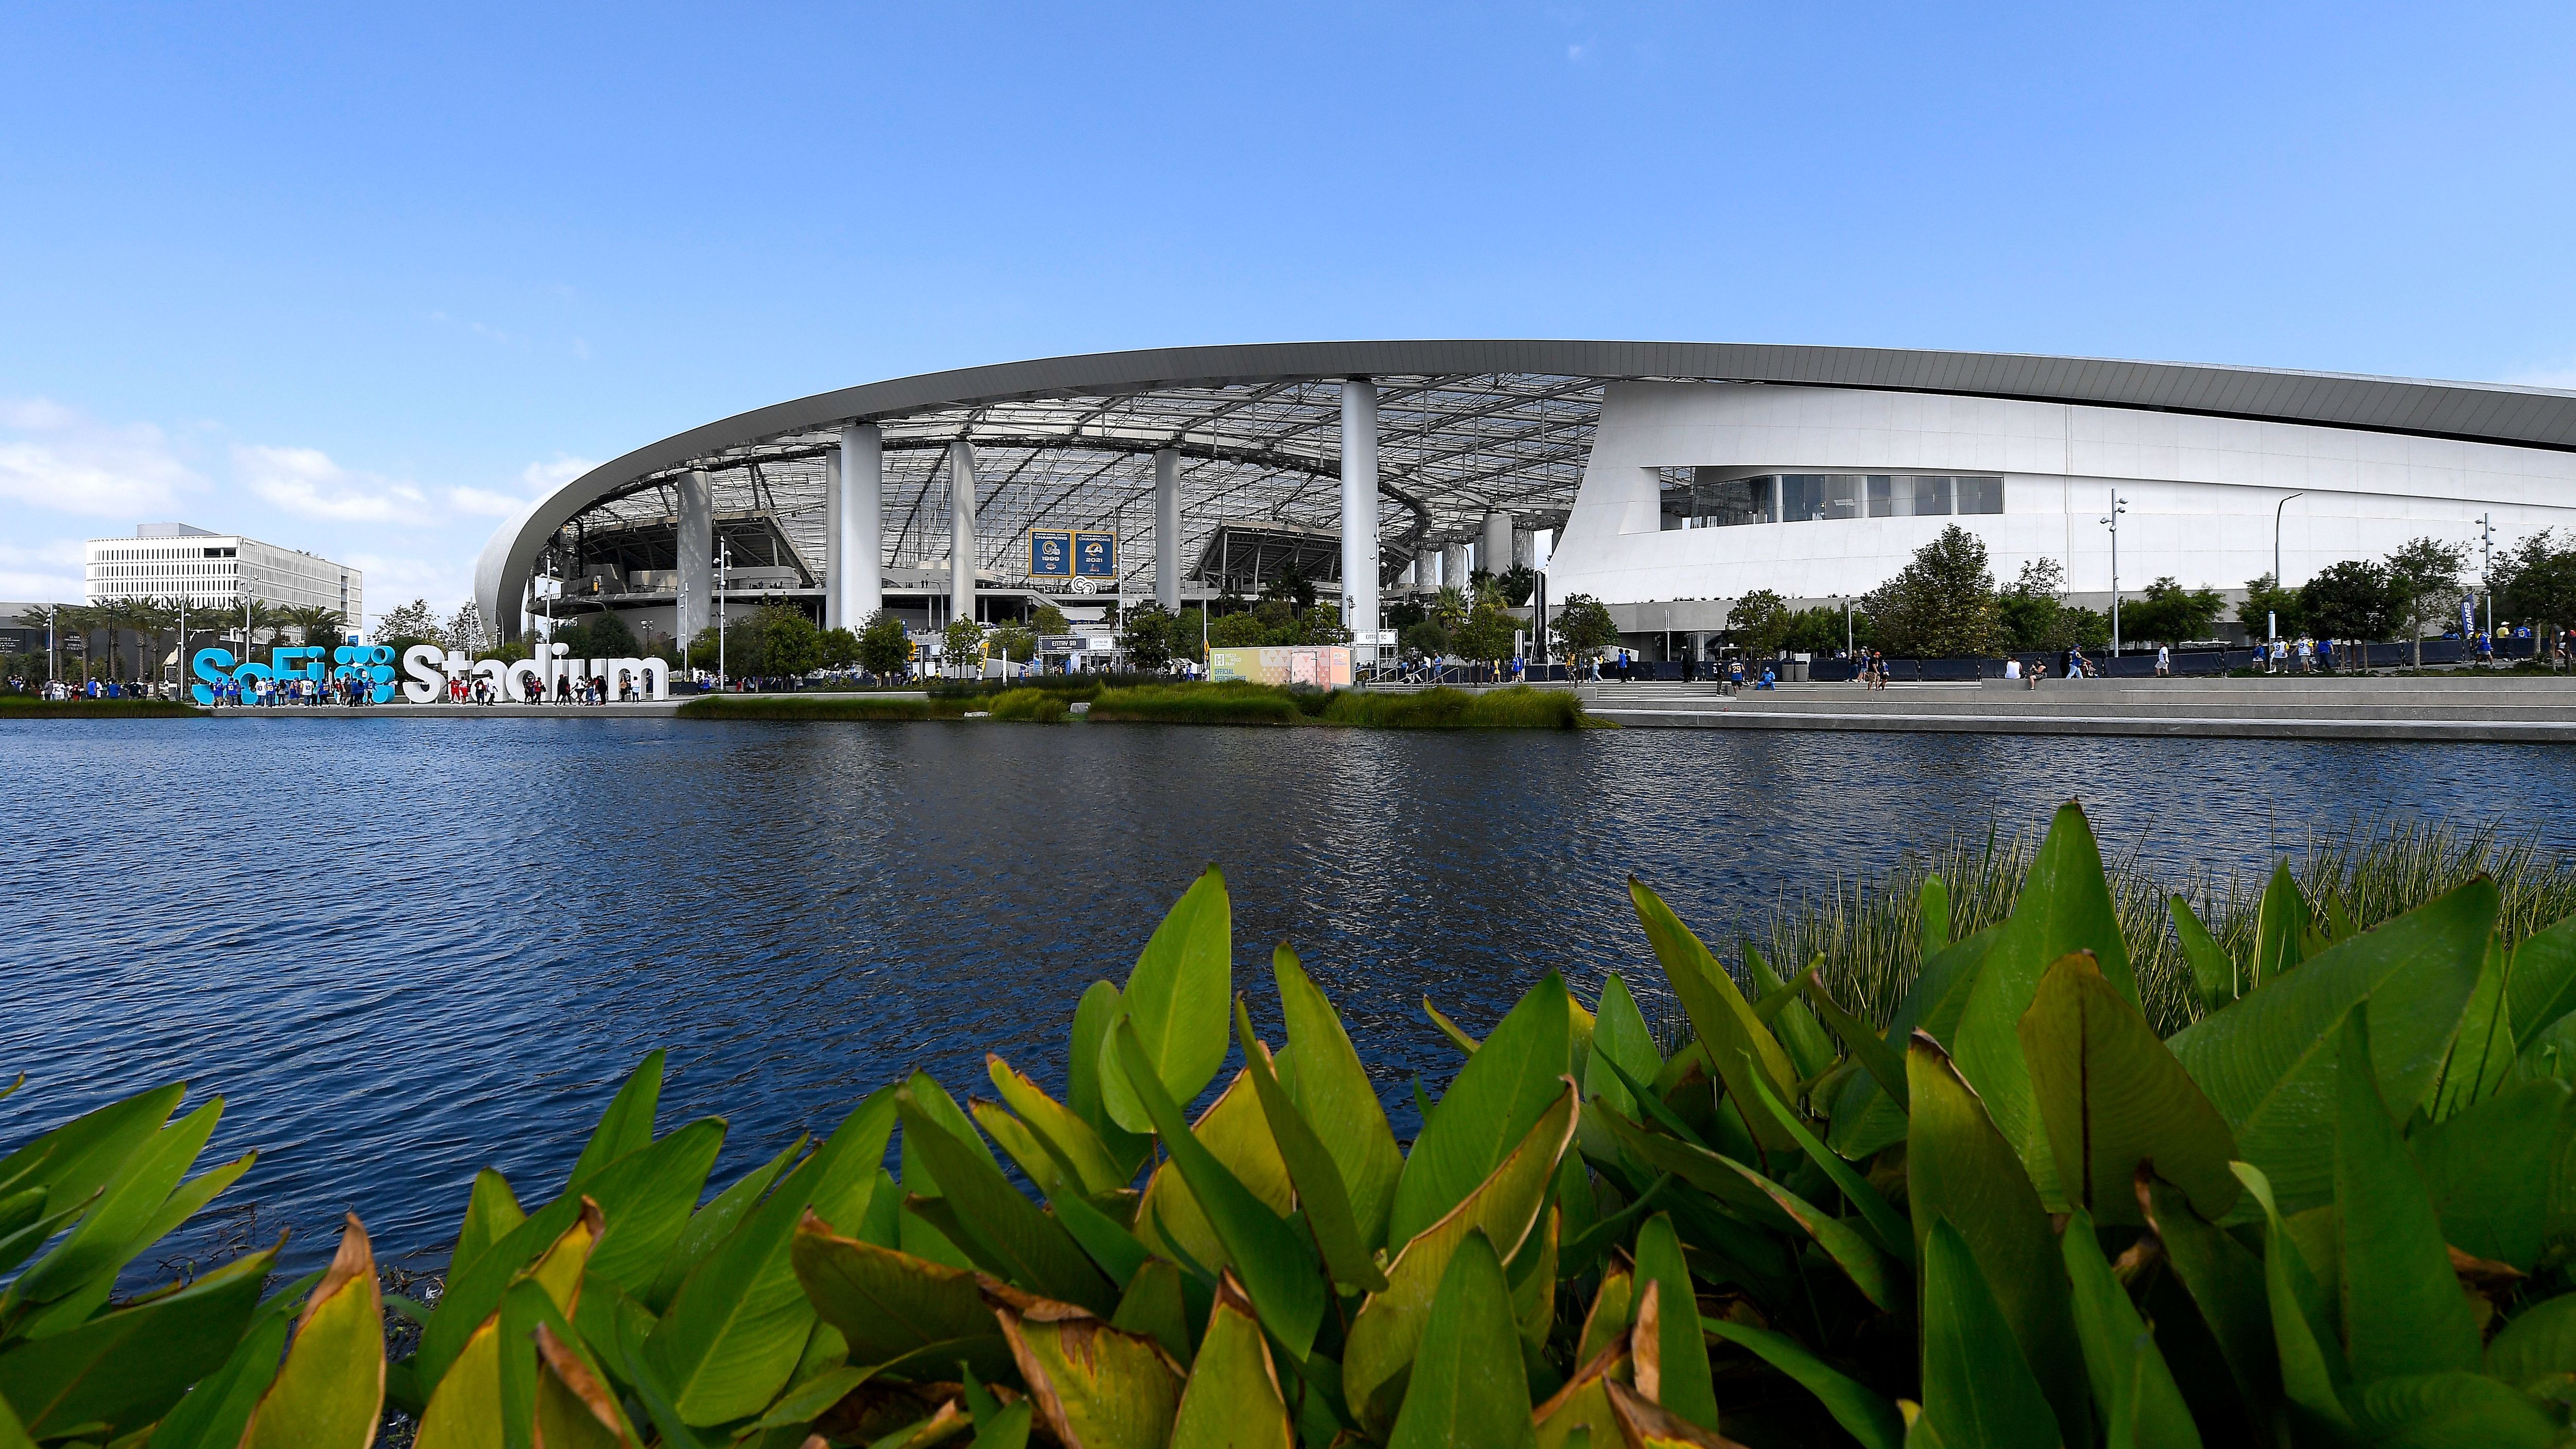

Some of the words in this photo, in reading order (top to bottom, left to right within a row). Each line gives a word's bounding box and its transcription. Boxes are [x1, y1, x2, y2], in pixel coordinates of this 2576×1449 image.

[2463, 602, 2474, 633] RAMS
[192, 646, 325, 705] SoFi
[403, 642, 669, 703] Stadium
